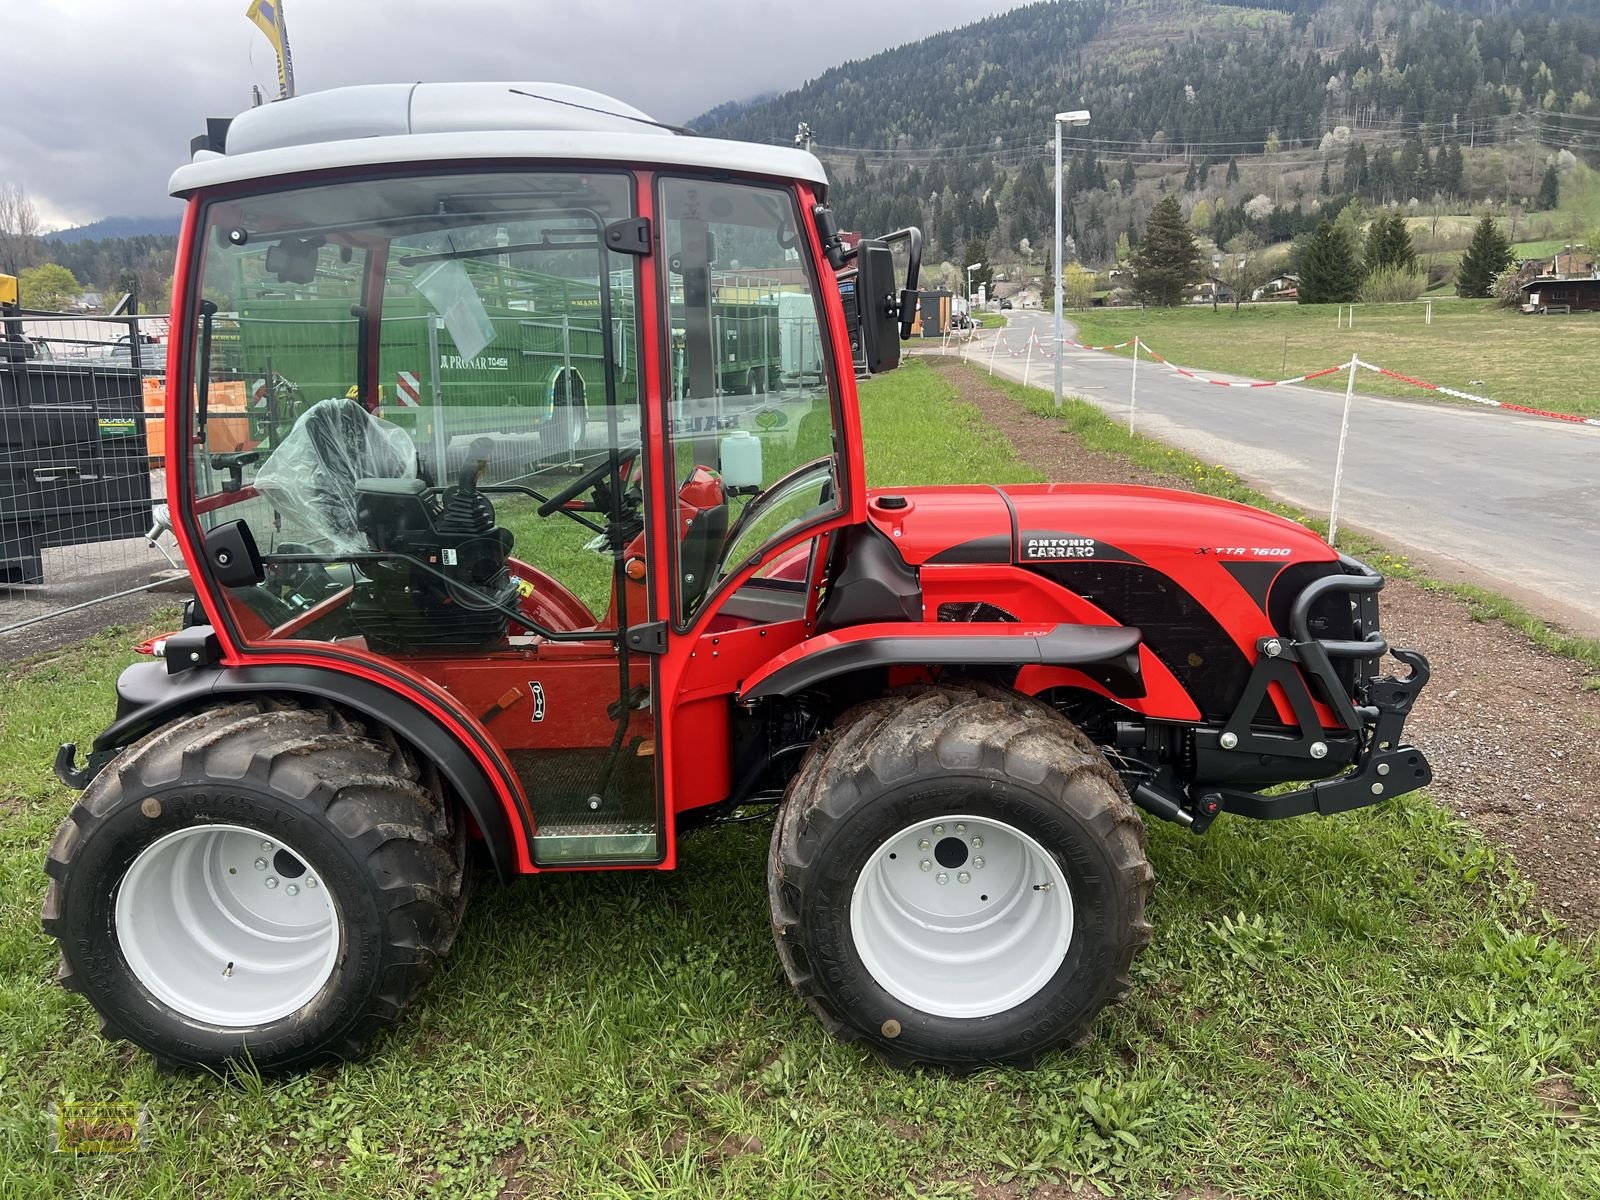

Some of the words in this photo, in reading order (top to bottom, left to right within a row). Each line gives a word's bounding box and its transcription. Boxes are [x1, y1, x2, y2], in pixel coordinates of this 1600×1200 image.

[450, 356, 487, 369] PRONAR
[1028, 539, 1094, 547] ANTONIO
[1028, 547, 1094, 557] CARRARO
[1215, 547, 1246, 555] TTR
[1250, 547, 1291, 556] 7600
